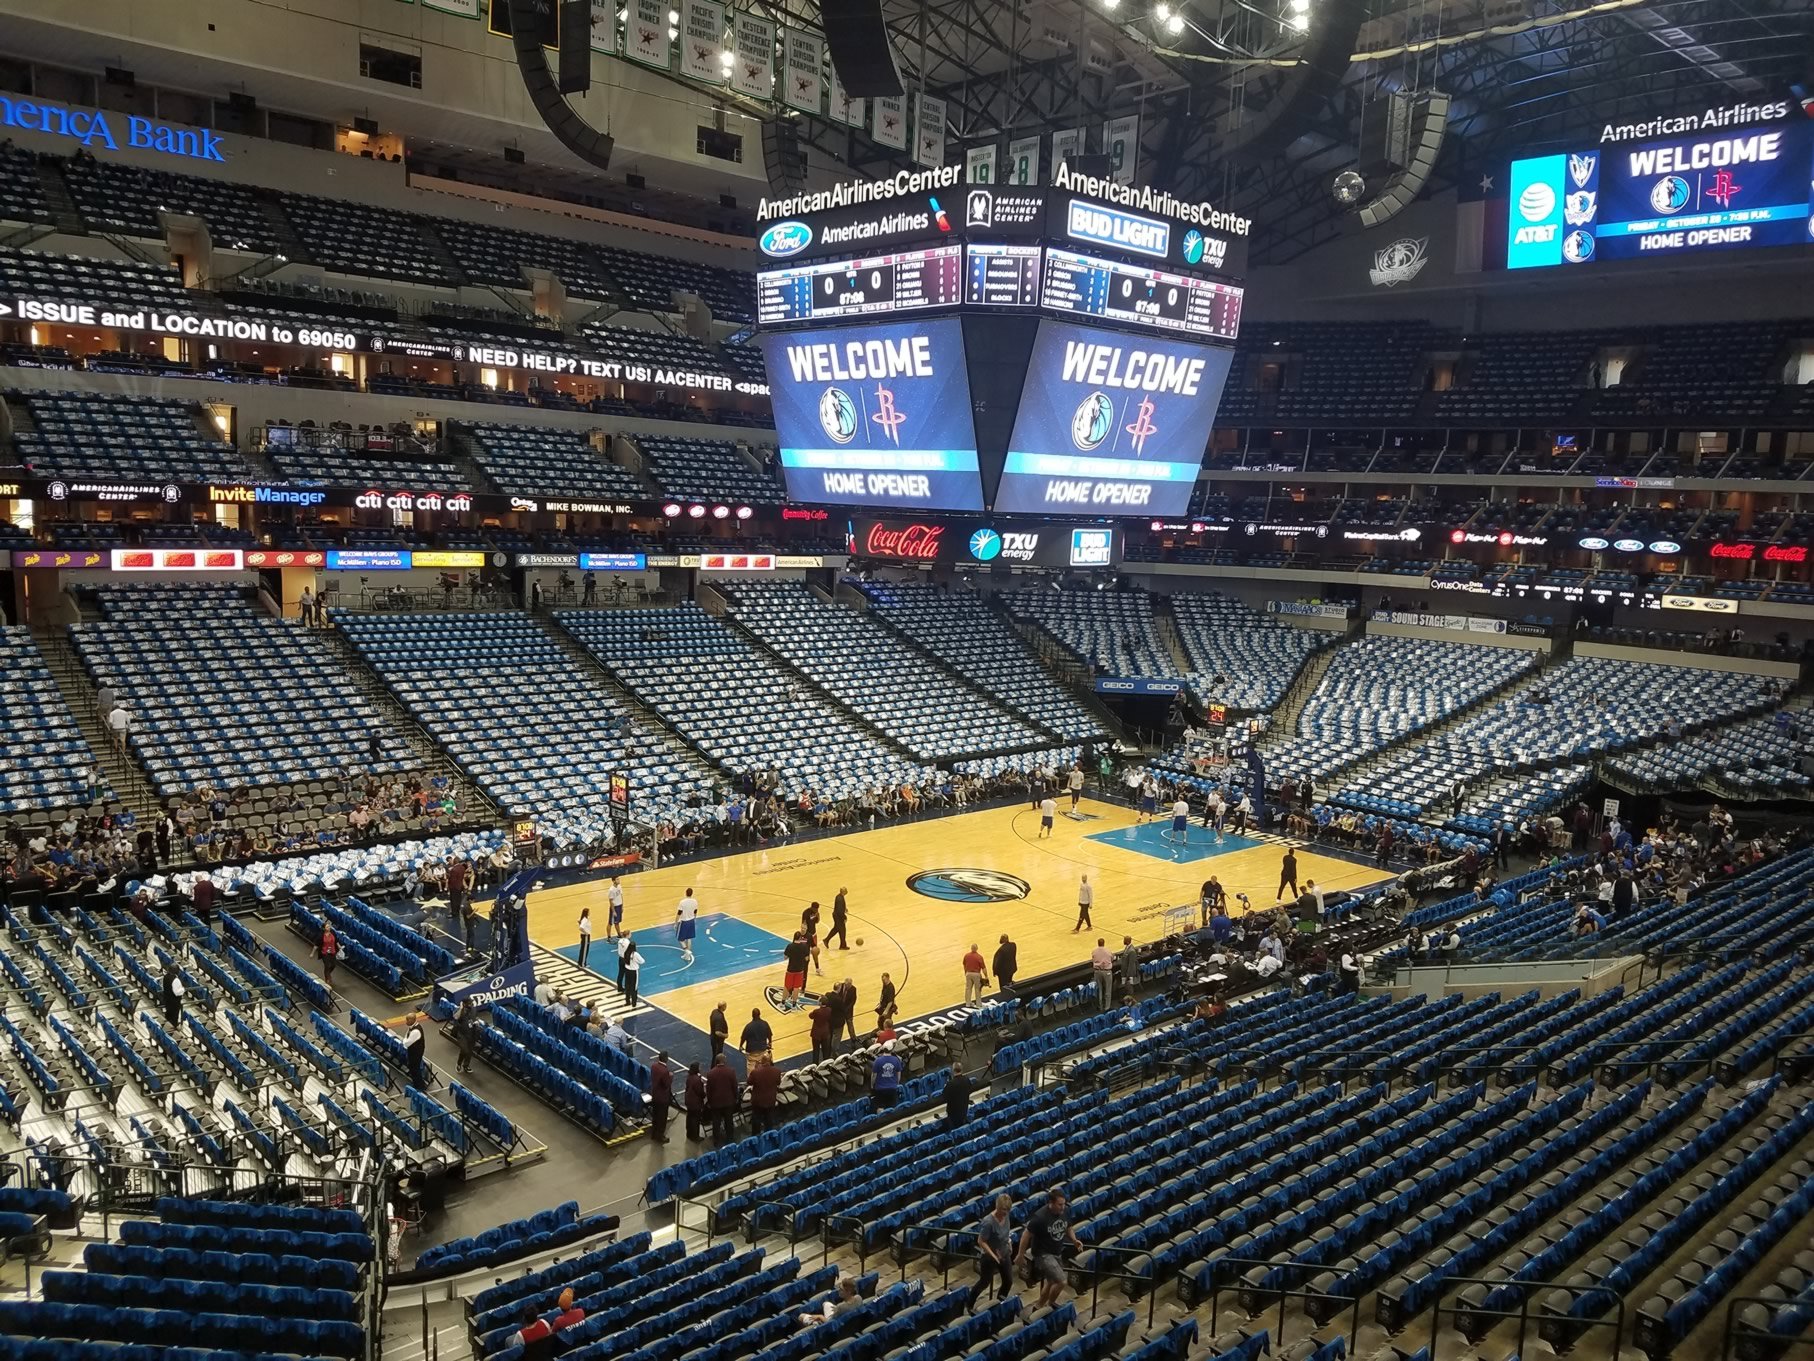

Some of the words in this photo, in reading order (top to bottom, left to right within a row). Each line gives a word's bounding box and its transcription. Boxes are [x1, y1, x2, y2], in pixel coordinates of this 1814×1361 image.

[691, 4, 714, 19] PACIFIC
[691, 16, 715, 31] DIVISION
[742, 20, 767, 36] WESTERN
[686, 26, 719, 44] CHAMPIONS
[738, 29, 771, 48] CONFERENCE
[739, 42, 769, 59] CHAMPIONS
[792, 37, 815, 53] CENTRAL
[793, 49, 815, 63] DIVISION
[790, 58, 818, 75] CHAMPIONS
[1600, 113, 1698, 144] American
[1702, 100, 1788, 129] Airlines
[127, 114, 225, 162] Bank
[1112, 139, 1125, 172] 9
[1629, 131, 1783, 178] WELCOME
[972, 163, 990, 185] 19
[1018, 155, 1029, 186] 8
[995, 197, 1043, 206] AMERICAN
[995, 205, 1037, 215] AIRLINES
[1071, 207, 1112, 239] BUD
[1113, 217, 1165, 251] LIGHT
[1514, 224, 1558, 245] AT&T
[1640, 232, 1685, 250] HOME
[1687, 226, 1752, 246] OPENER
[1202, 237, 1227, 258] TXU
[1202, 254, 1225, 269] energy
[824, 277, 835, 295] 0
[871, 270, 882, 290] 0
[1122, 279, 1133, 298] 0
[1167, 288, 1178, 306] 0
[18, 300, 96, 325] ISSUE
[101, 311, 145, 329] and
[151, 313, 266, 341] LOCATION
[272, 326, 294, 344] to
[298, 329, 357, 351] 69050
[786, 336, 934, 383] WELCOME
[1062, 340, 1206, 396] WELCOME
[469, 347, 519, 368] NEED
[522, 350, 577, 374] HELP?
[581, 360, 622, 380] TEXT
[625, 364, 652, 382] US!
[655, 369, 733, 392] AACENTER
[823, 472, 866, 495] HOME
[868, 473, 931, 498] OPENER
[1045, 479, 1091, 503] HOME
[1092, 482, 1153, 505] OPENER
[98, 492, 139, 501] CENTER
[209, 486, 326, 506] InviteManager
[355, 491, 382, 509] citi
[386, 493, 412, 510] citi
[416, 494, 442, 511] citi
[446, 495, 471, 512] citi
[546, 502, 569, 512] MIKE
[571, 503, 613, 514] BOWMAN,
[615, 504, 634, 514] INC.
[811, 509, 829, 520] Coffee
[1002, 532, 1039, 551] TXU
[1080, 533, 1106, 549] BUD
[372, 559, 391, 567] Plano
[1001, 548, 1036, 561] energy
[1074, 547, 1110, 562] LIGHT
[1431, 579, 1470, 591] CyrusOne
[1391, 611, 1419, 625] SOUND
[1419, 614, 1446, 628] STAGE
[1102, 681, 1135, 690] GEICO
[1147, 683, 1180, 691] GEICO
[1211, 711, 1223, 720] 24
[519, 831, 531, 840] 24
[469, 981, 529, 1008] SPALDING
